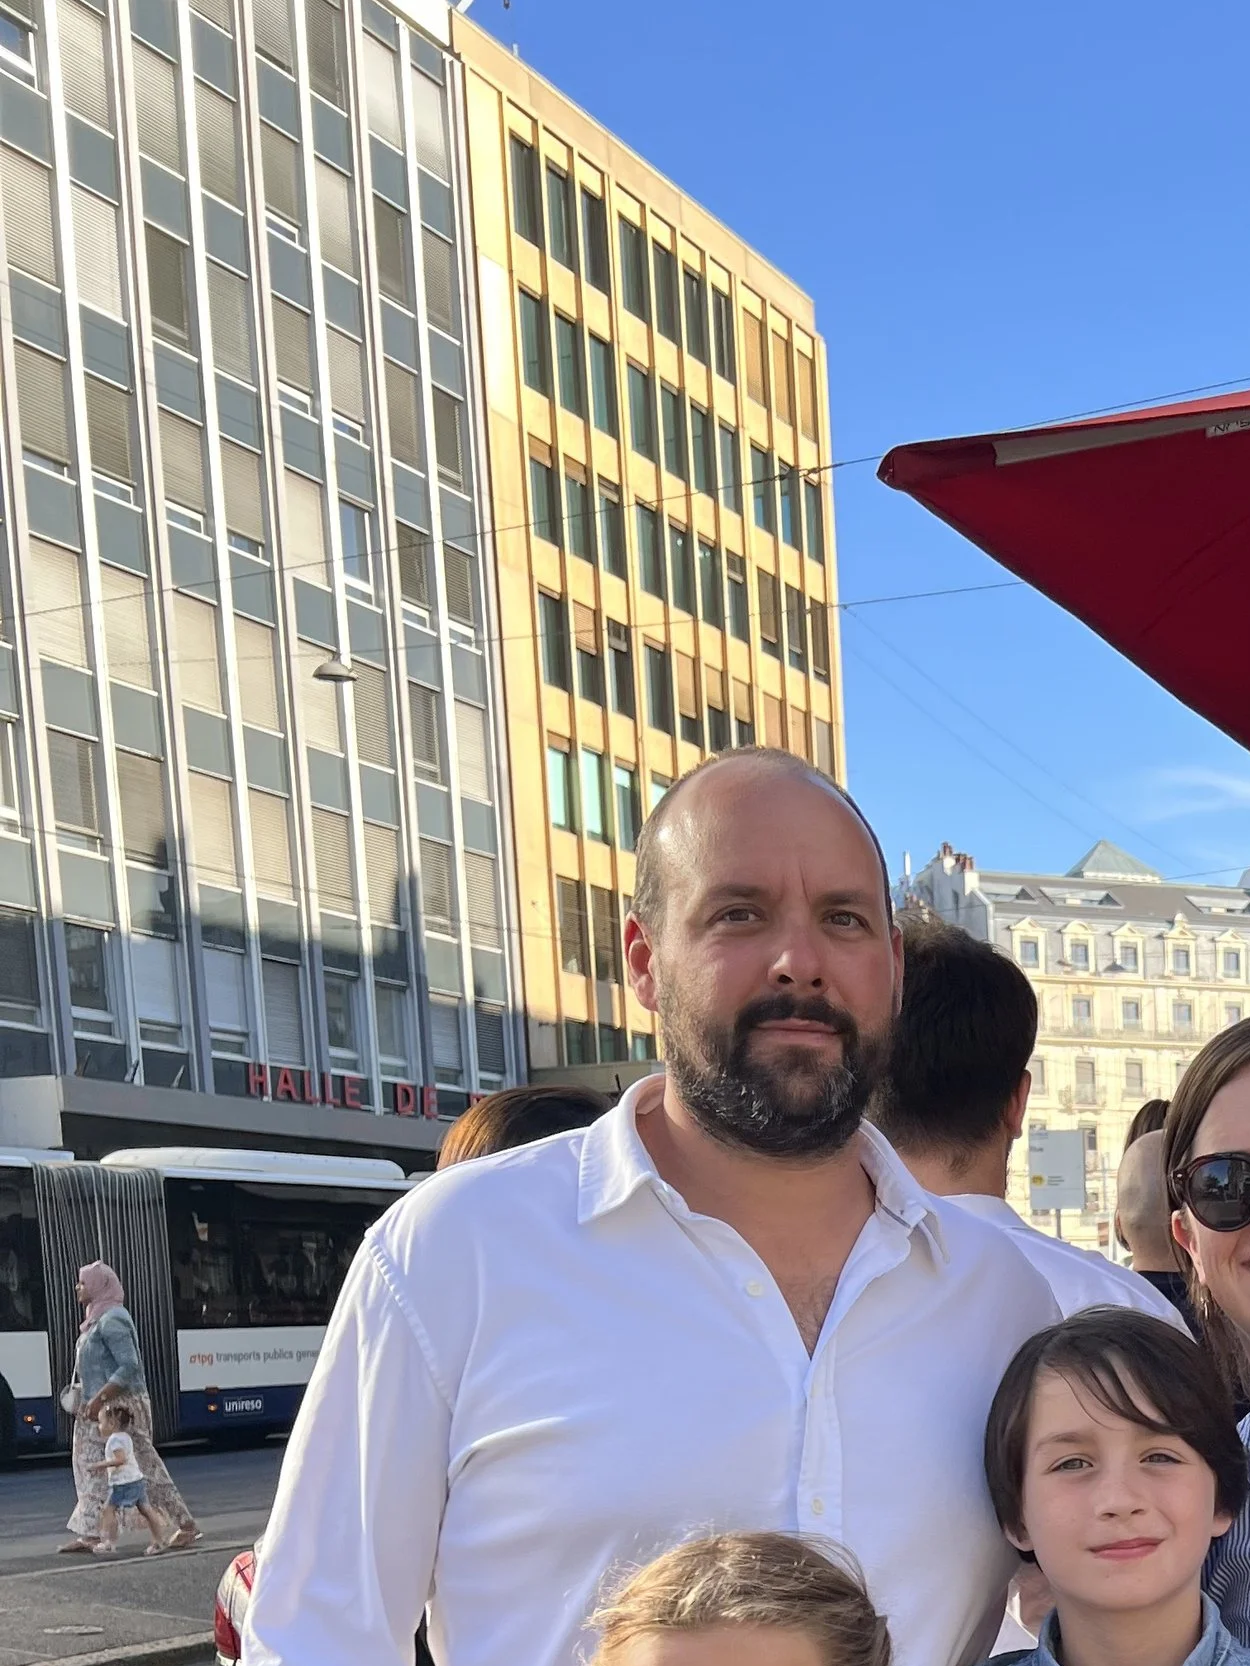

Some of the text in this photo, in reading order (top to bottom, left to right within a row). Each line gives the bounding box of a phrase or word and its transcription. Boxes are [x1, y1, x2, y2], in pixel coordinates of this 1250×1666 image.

[249, 1063, 439, 1119] HALLE DE
[216, 1350, 260, 1364] transports
[263, 1348, 293, 1362] publics
[225, 1399, 262, 1412] unireso
